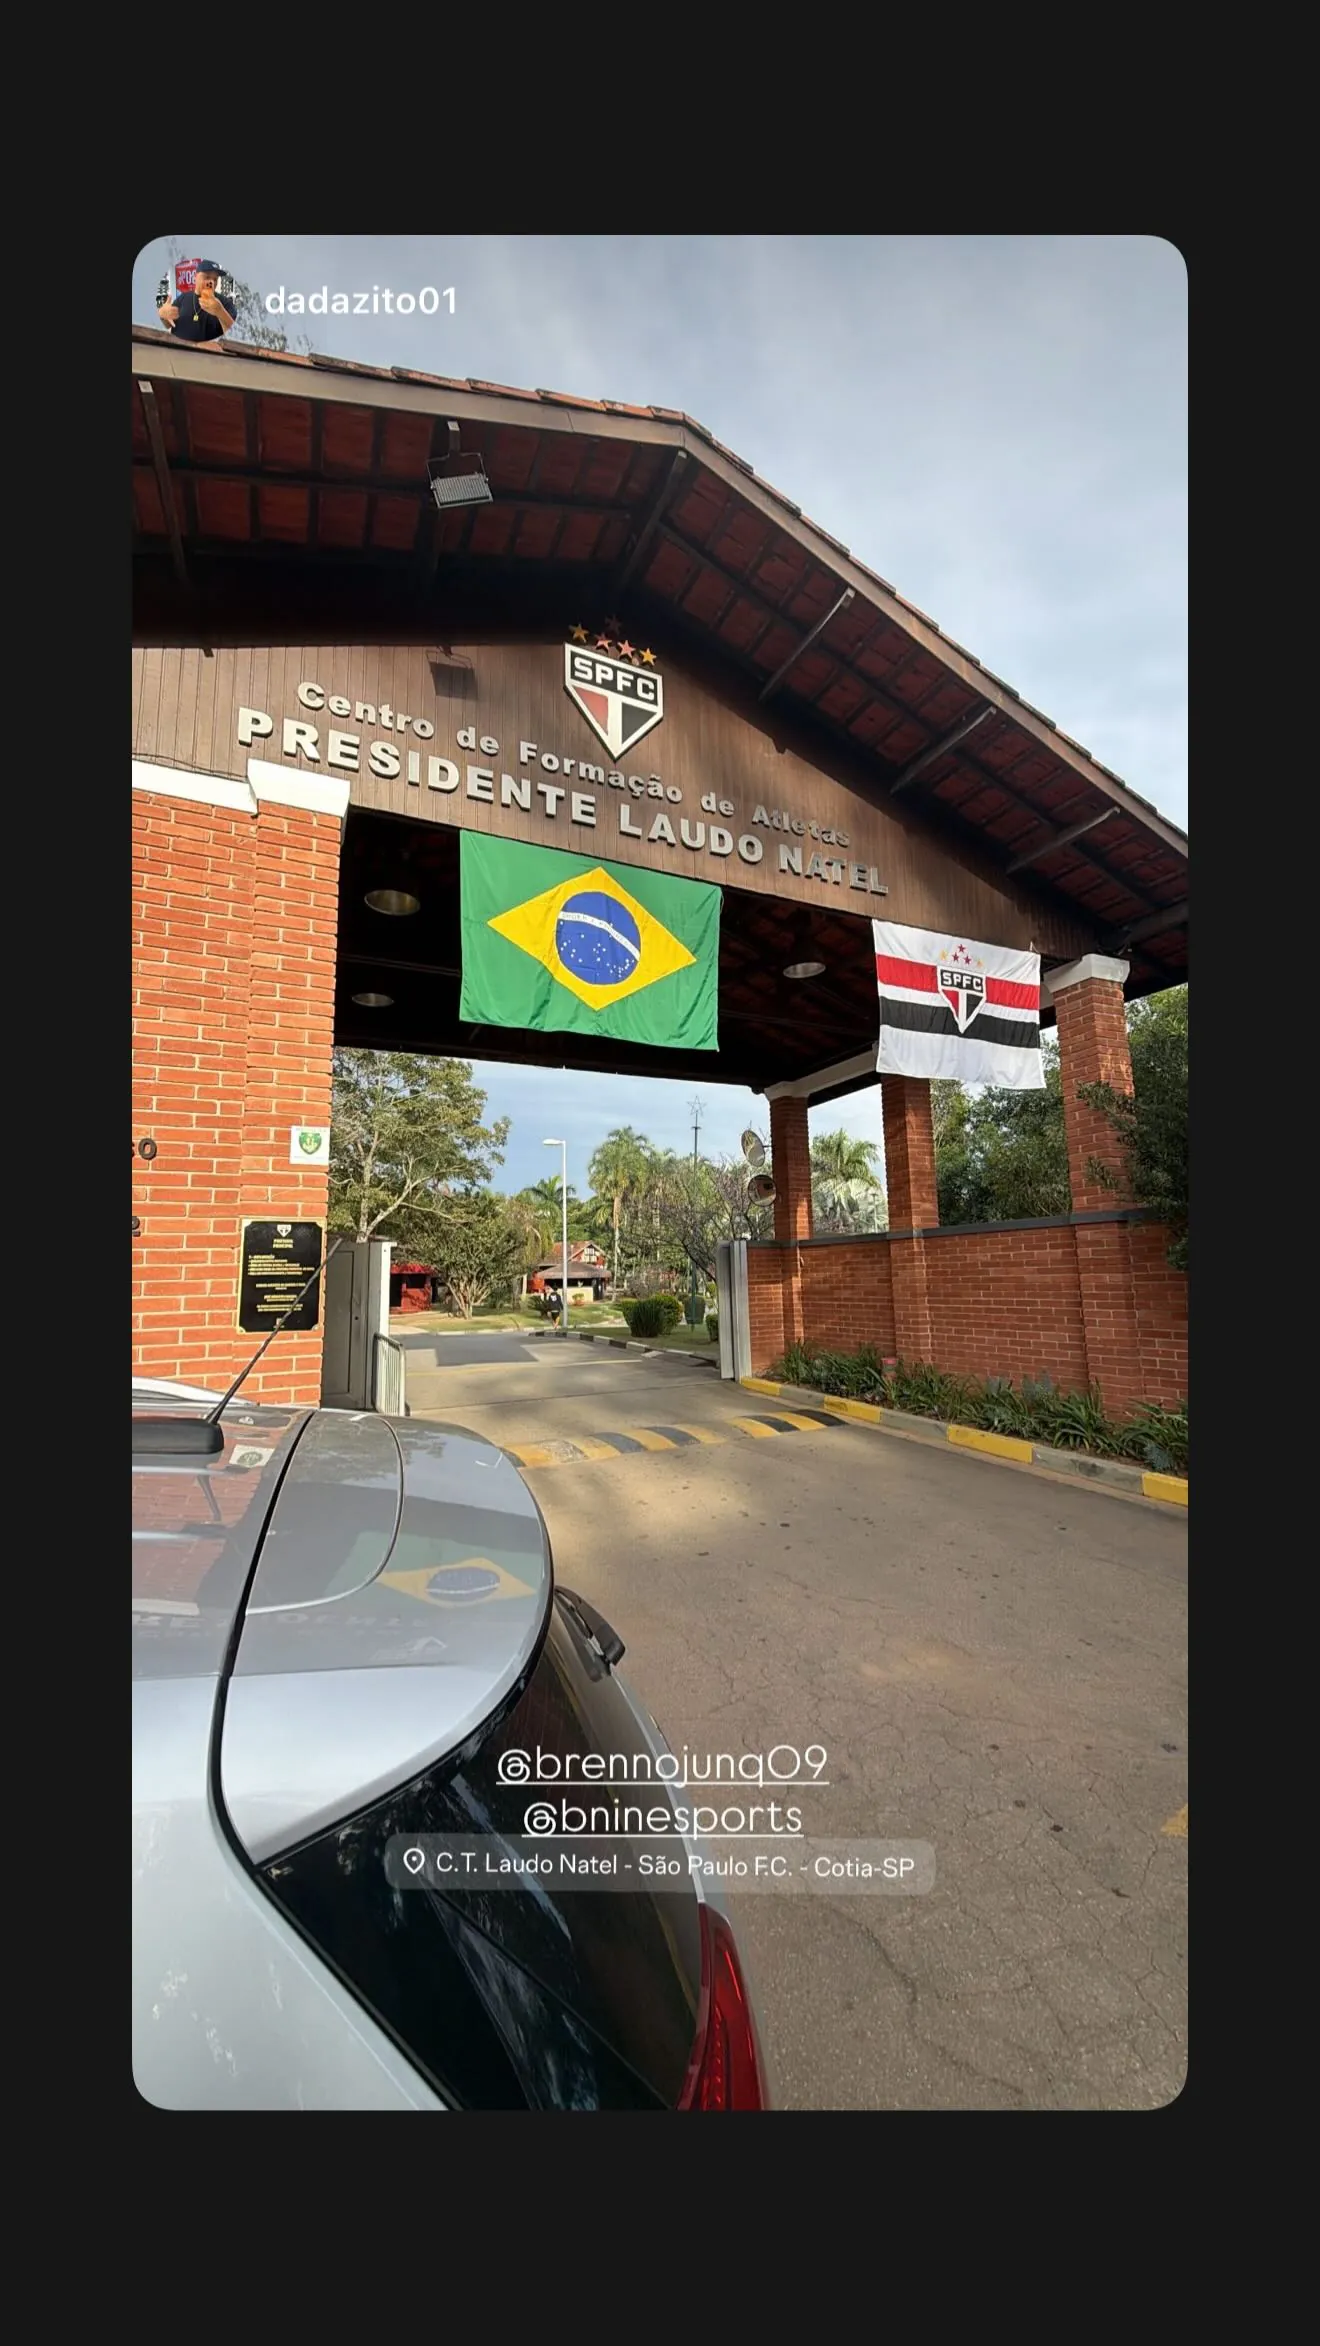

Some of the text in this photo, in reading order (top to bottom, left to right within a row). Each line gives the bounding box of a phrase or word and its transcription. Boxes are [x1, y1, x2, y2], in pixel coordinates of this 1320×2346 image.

[574, 656, 655, 701] SPFC
[237, 706, 889, 896] PRESIDENTE LAUDO NATEL
[297, 681, 850, 848] Centro de Formação de Atletas
[942, 971, 983, 991] SPFC
